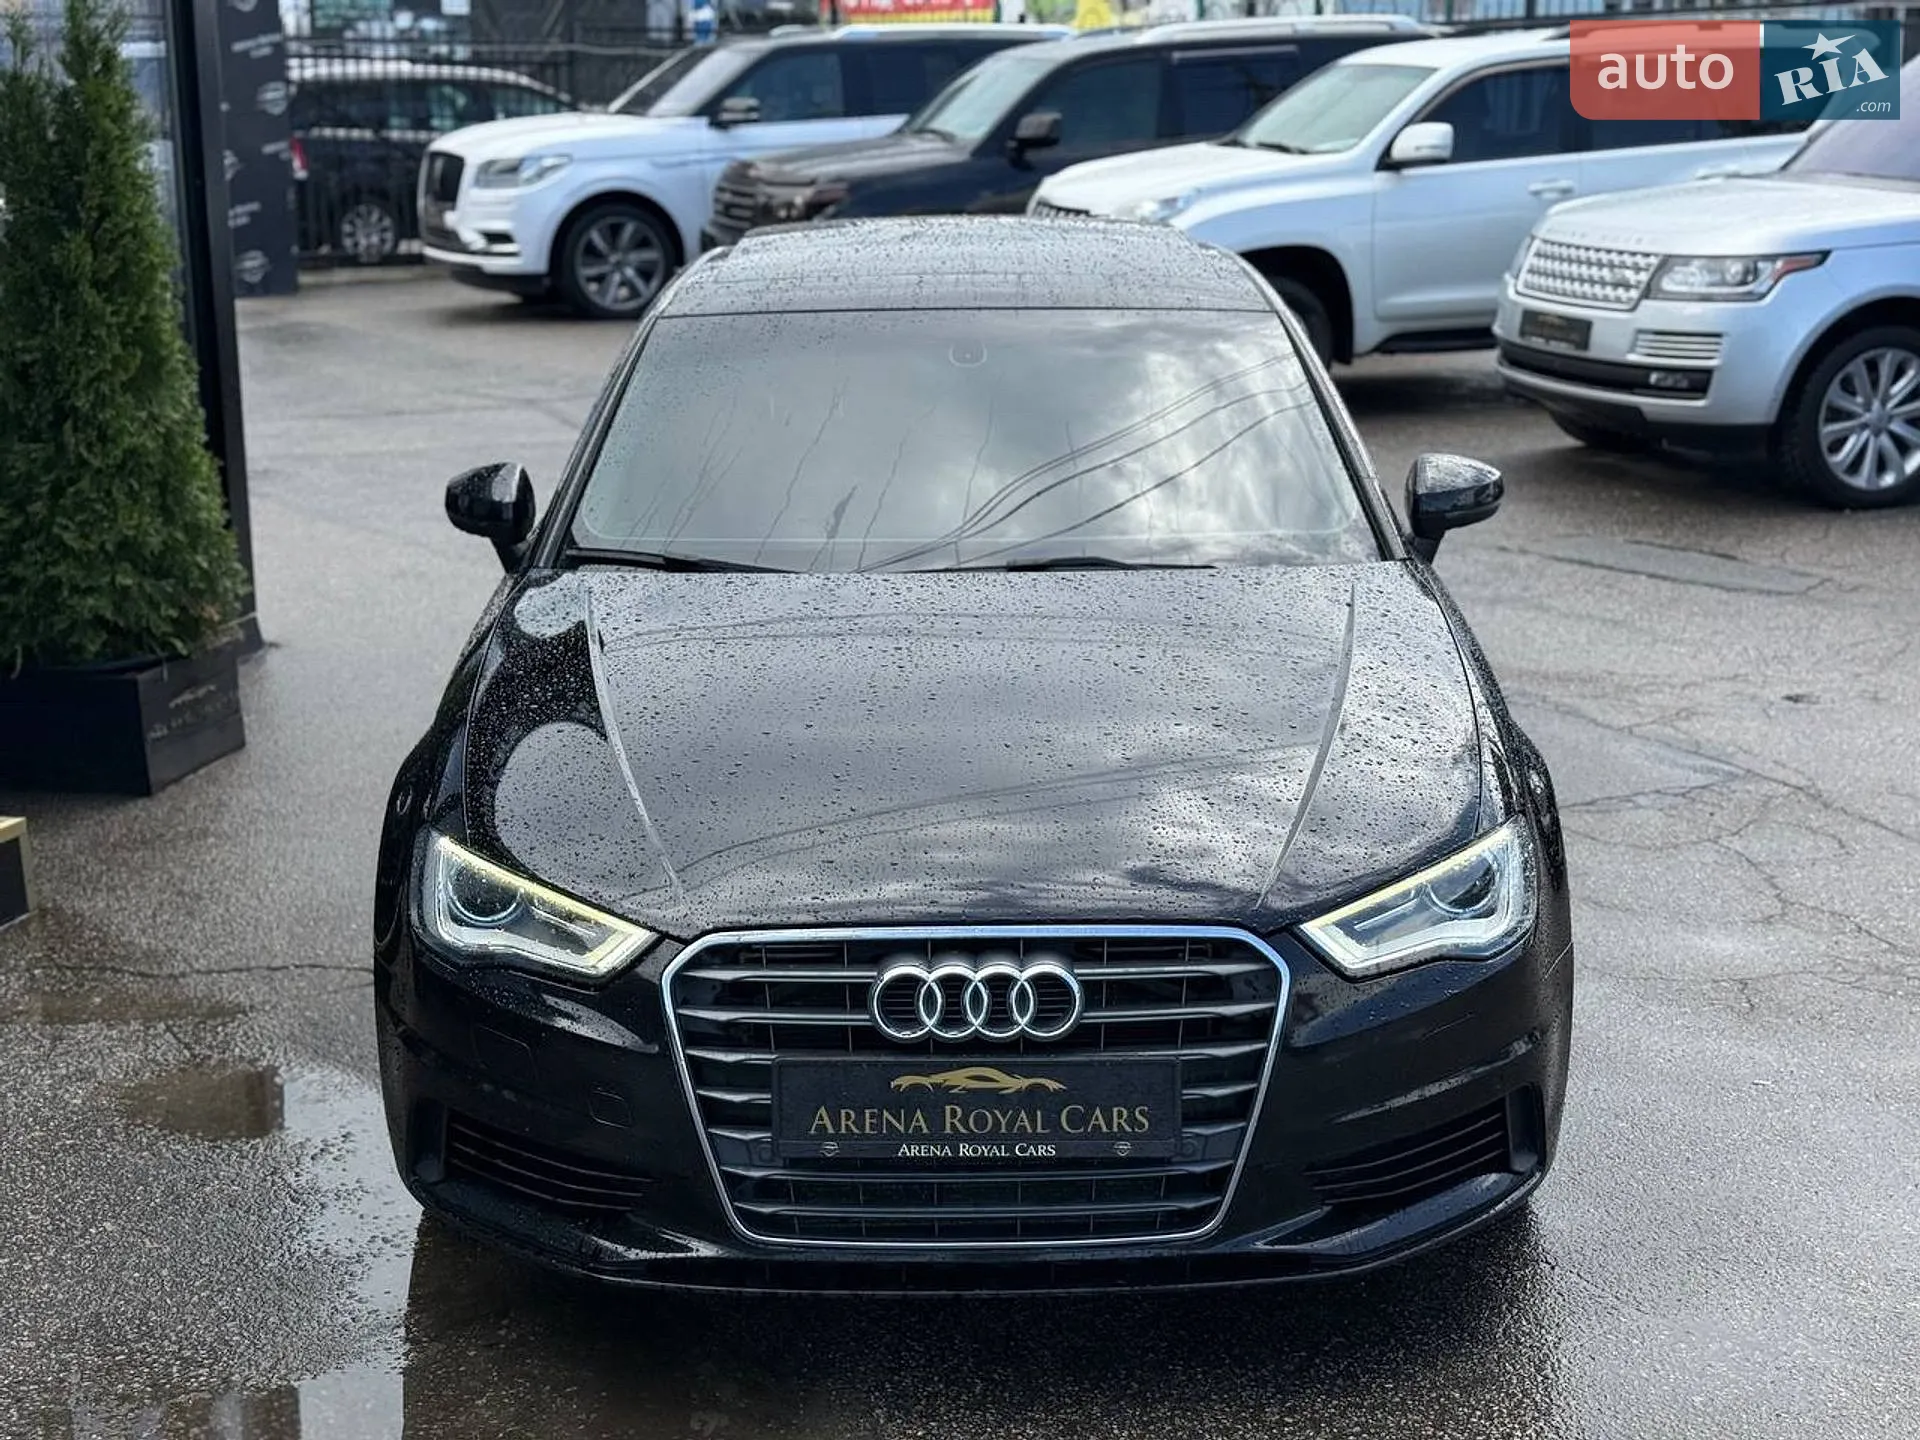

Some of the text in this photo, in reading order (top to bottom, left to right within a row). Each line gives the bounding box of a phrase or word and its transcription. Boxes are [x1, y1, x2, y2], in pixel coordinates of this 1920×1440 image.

[807, 1104, 1150, 1135] ARENA ROYAL CARS
[897, 1142, 1057, 1157] ARENA ROYAL CARS
